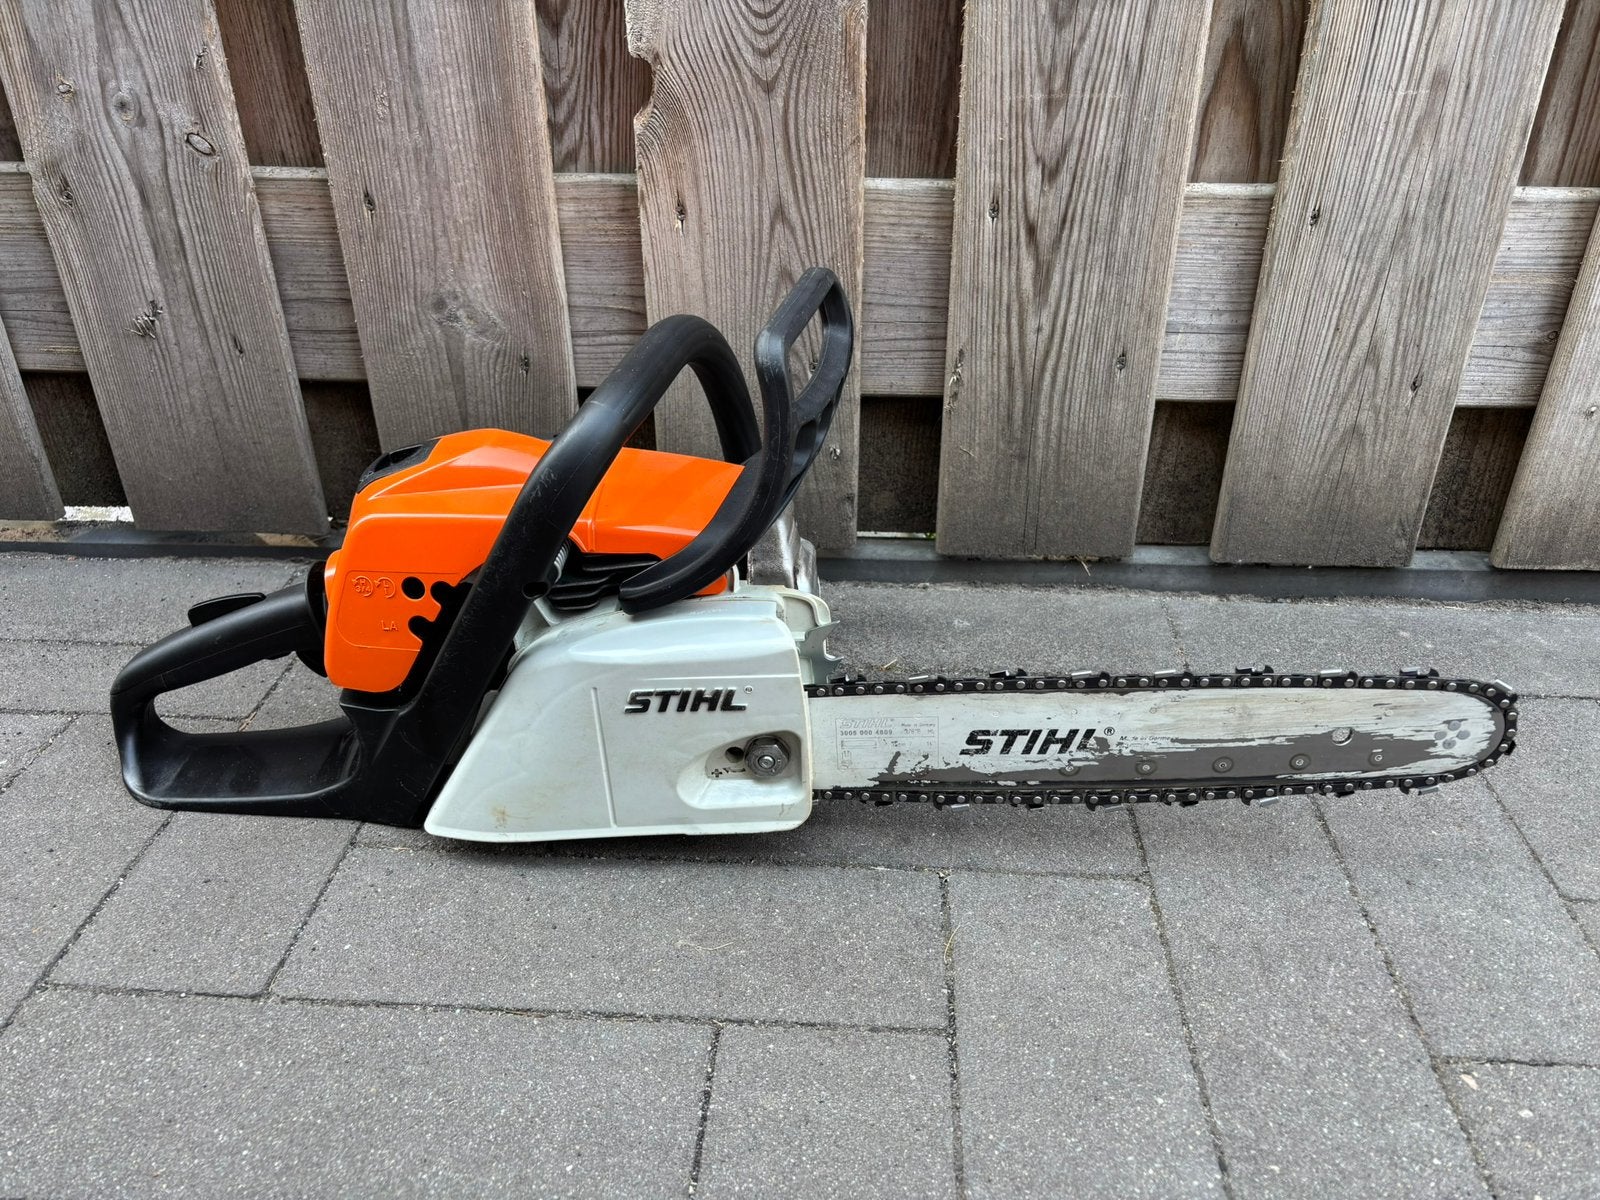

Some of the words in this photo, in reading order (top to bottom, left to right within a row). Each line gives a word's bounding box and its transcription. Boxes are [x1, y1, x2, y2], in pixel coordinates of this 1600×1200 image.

[381, 620, 399, 632] LA
[624, 687, 748, 713] STIHL
[840, 718, 890, 729] STIHL
[859, 728, 873, 736] 000
[959, 728, 1097, 756] STIHL
